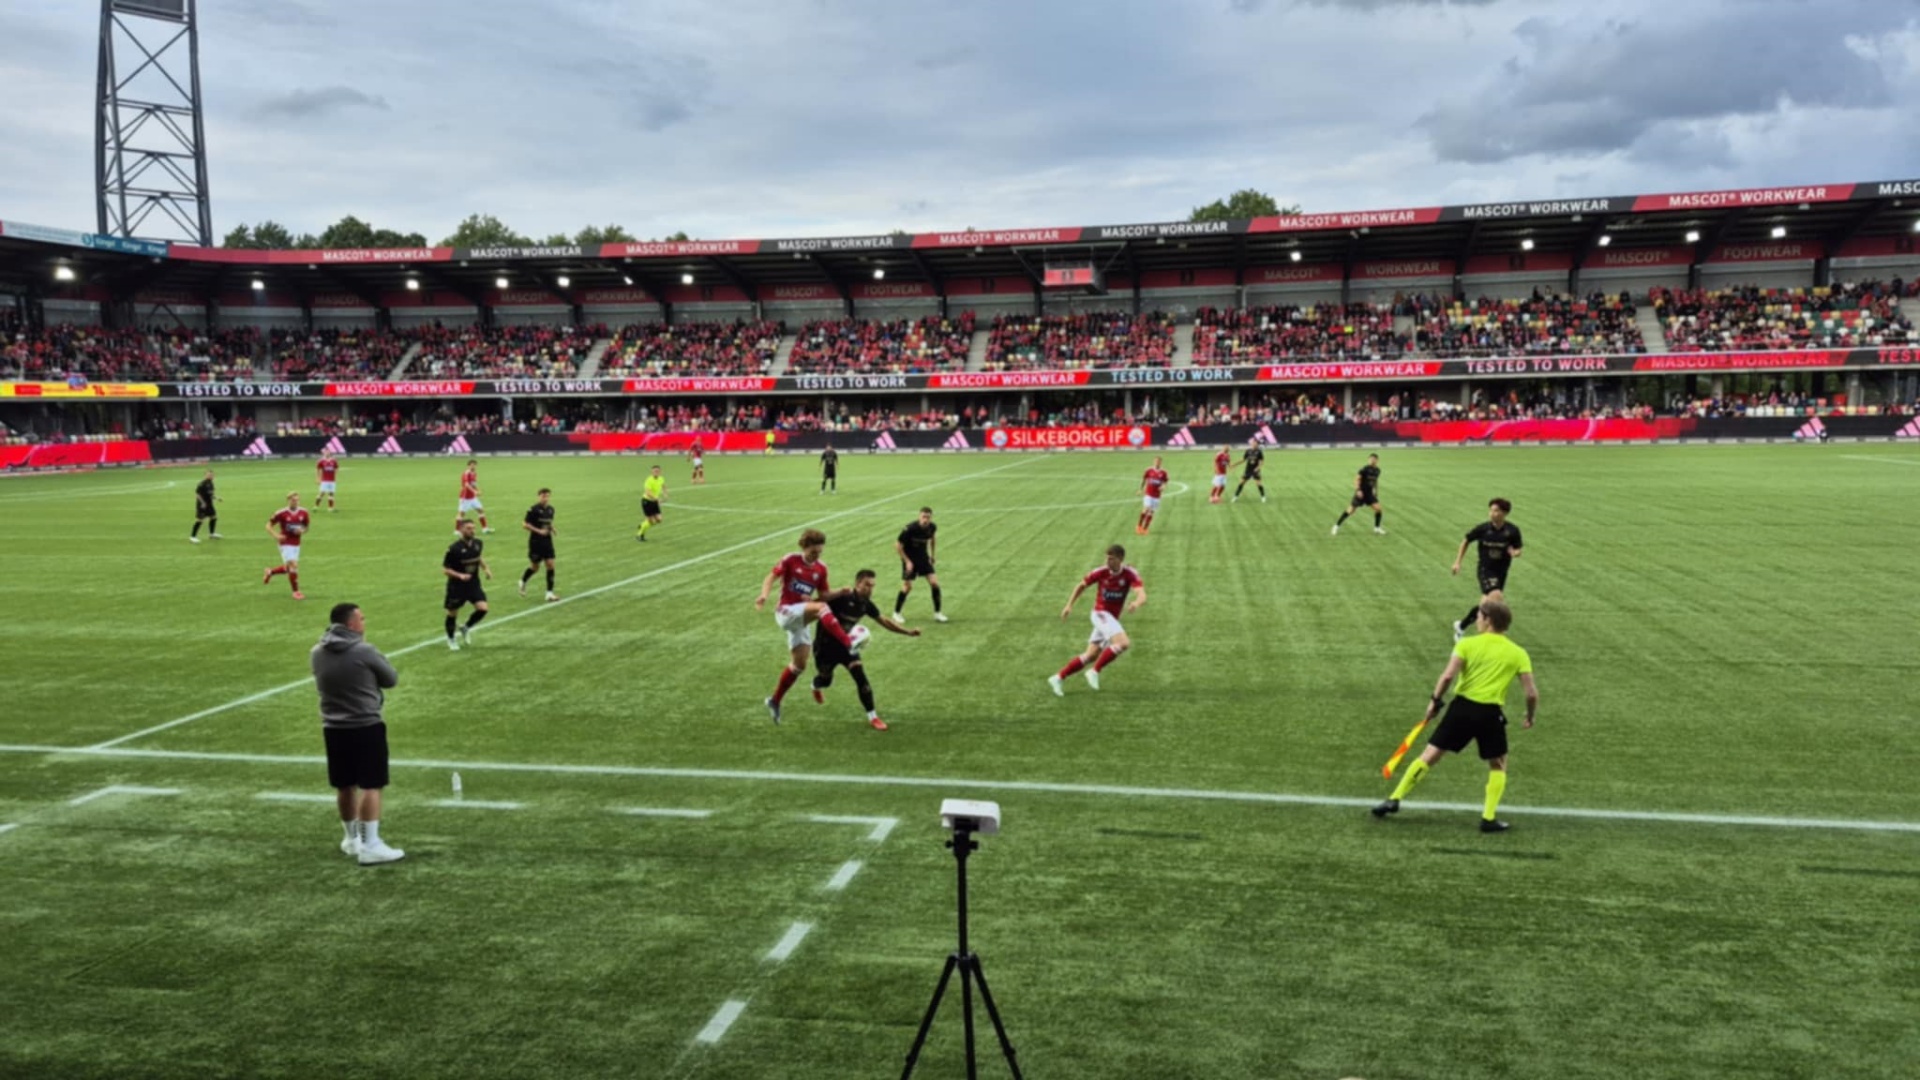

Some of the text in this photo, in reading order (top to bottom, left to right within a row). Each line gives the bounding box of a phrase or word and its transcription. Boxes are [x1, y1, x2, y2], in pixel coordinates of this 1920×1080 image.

[1740, 188, 1826, 203] WORKWEAR
[1529, 199, 1609, 213] WORKWEAR
[1341, 211, 1414, 224] WORKWEAR
[1159, 221, 1229, 235] WORKWEAR
[994, 230, 1059, 242] WORKWEAR
[678, 241, 739, 252] WORKWEAR
[831, 237, 893, 249] WORKWEAR
[373, 249, 432, 261] WORKWEAR
[522, 246, 582, 257] WORKWEAR
[1340, 363, 1425, 377] WORKWEAR
[1466, 357, 1607, 373] TESTED TO WORK
[1002, 373, 1076, 385] WORKWEAR
[1112, 369, 1233, 382] TESTED TO WORK
[394, 383, 461, 394] WORKWEAR
[495, 381, 602, 393] TESTED TO WORK
[692, 379, 762, 390] WORKWEAR
[796, 377, 906, 389] TESTED TO WORK
[178, 384, 302, 397] TESTED TO WORK
[1012, 429, 1124, 445] SILKEBORG IF
